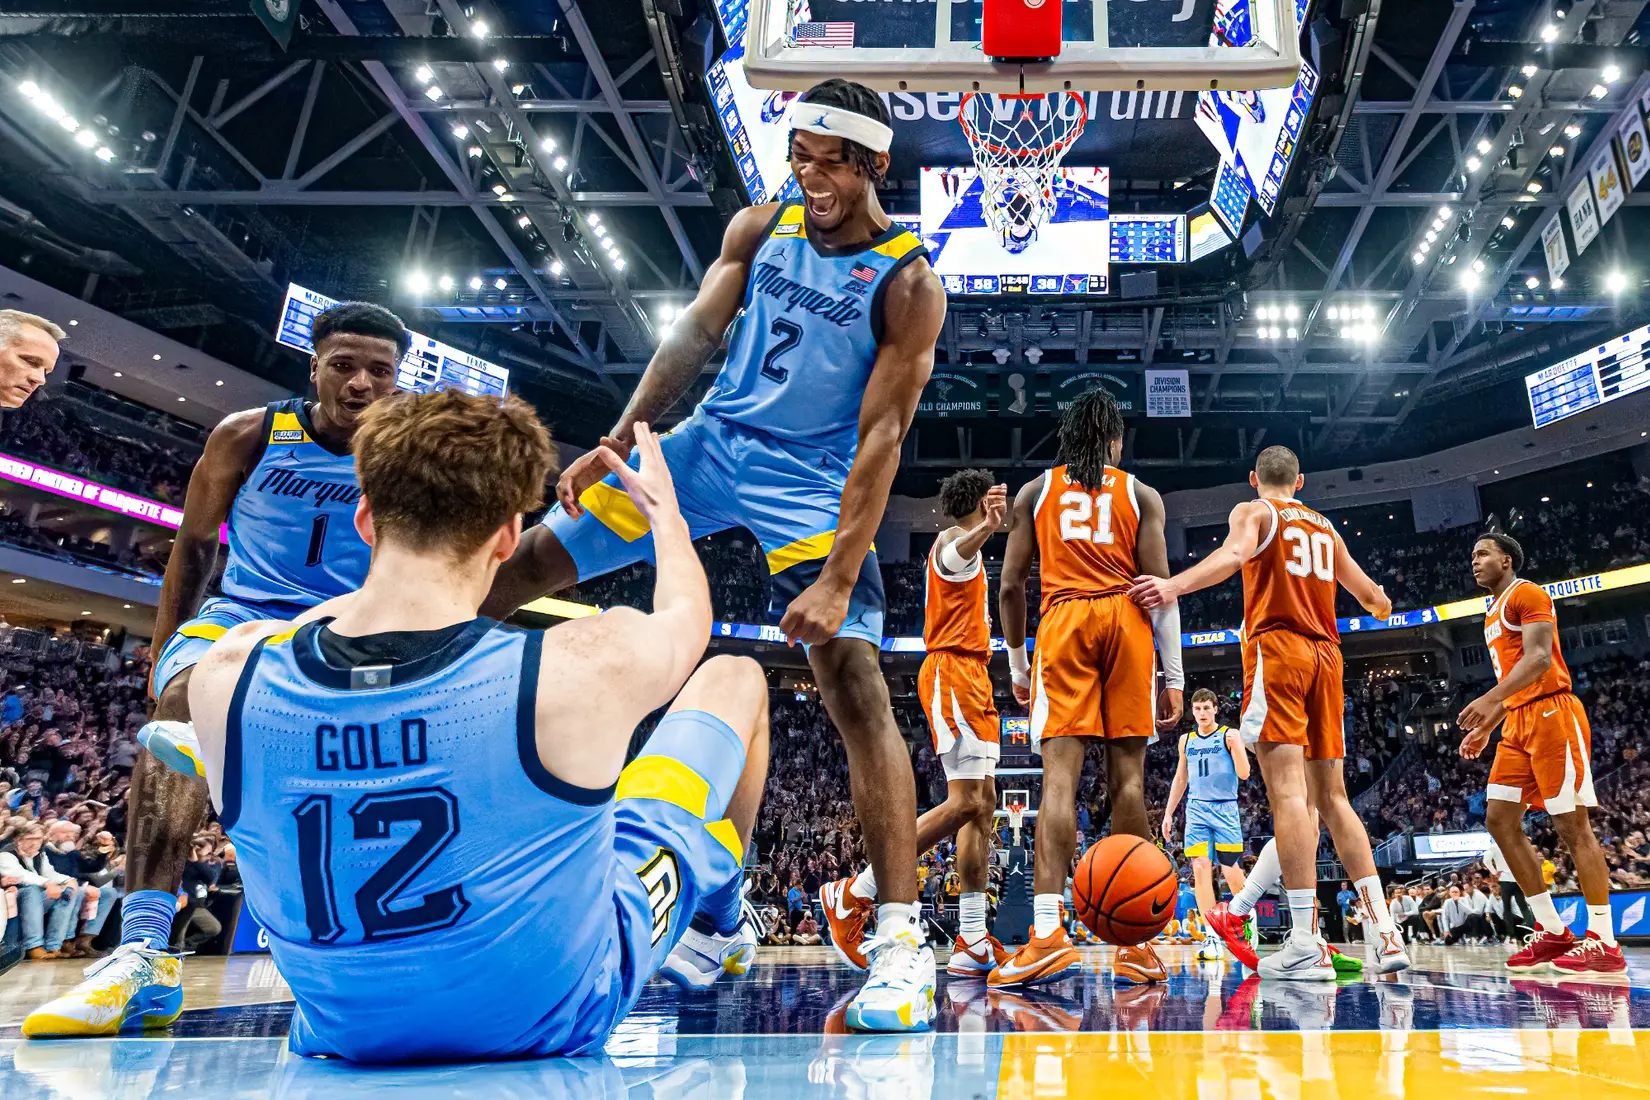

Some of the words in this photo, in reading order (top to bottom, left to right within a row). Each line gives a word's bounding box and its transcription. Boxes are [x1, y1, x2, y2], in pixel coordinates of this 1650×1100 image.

[754, 262, 862, 328] Marquette
[466, 355, 488, 371] TEXAS
[759, 317, 804, 384] 2
[1154, 377, 1181, 385] DIVISION
[1537, 358, 1578, 381] MARQUETTE
[1150, 385, 1186, 393] CHAMPIONS
[918, 402, 933, 411] RLD
[935, 402, 981, 411] CHAMPIONS
[257, 467, 362, 508] Marque
[1060, 491, 1115, 544] 21
[305, 513, 330, 567] 1
[1283, 526, 1334, 582] 30
[1543, 575, 1602, 598] RQUETTE
[1190, 632, 1226, 645] TEXAS
[315, 717, 428, 771] GOLD
[1197, 757, 1210, 778] 11
[291, 786, 473, 945] 12
